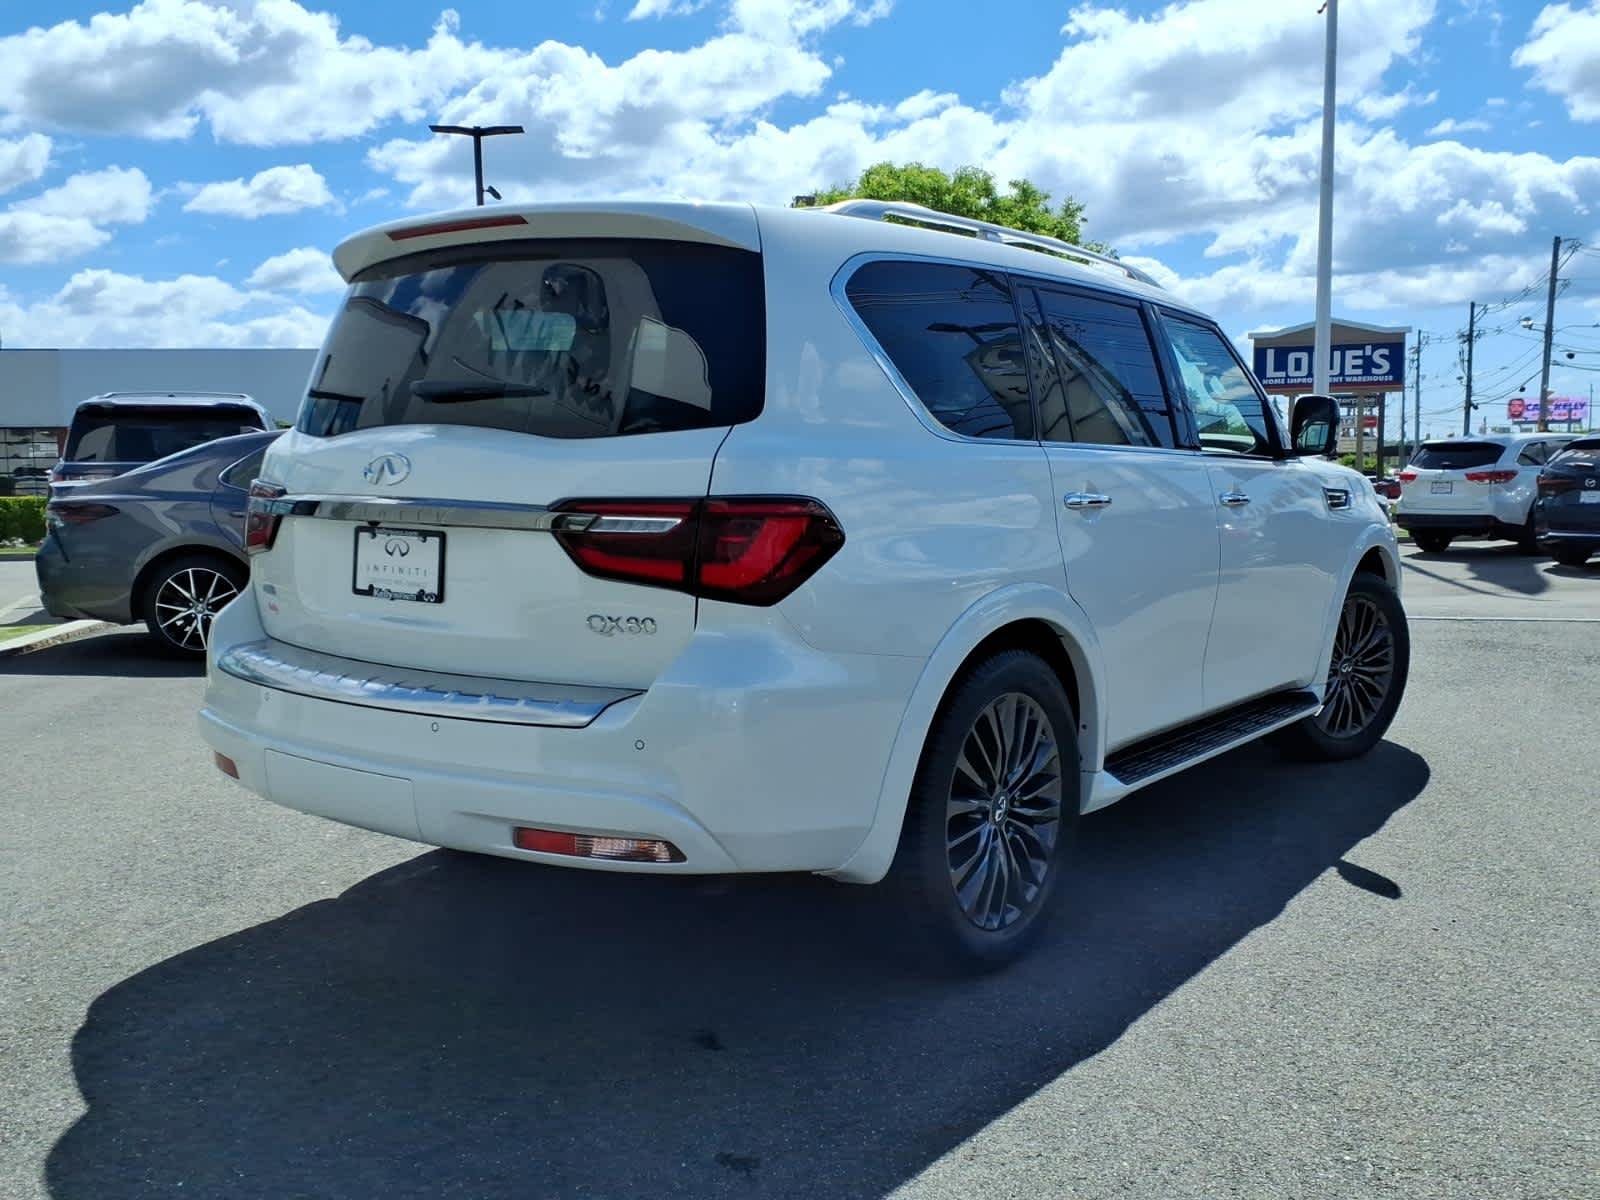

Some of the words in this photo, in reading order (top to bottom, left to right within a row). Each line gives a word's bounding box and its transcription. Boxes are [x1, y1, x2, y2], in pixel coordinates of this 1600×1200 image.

[1287, 376, 1342, 384] IMPROENT
[1345, 375, 1393, 383] WAREHOUSE
[367, 564, 427, 577] INFINITI
